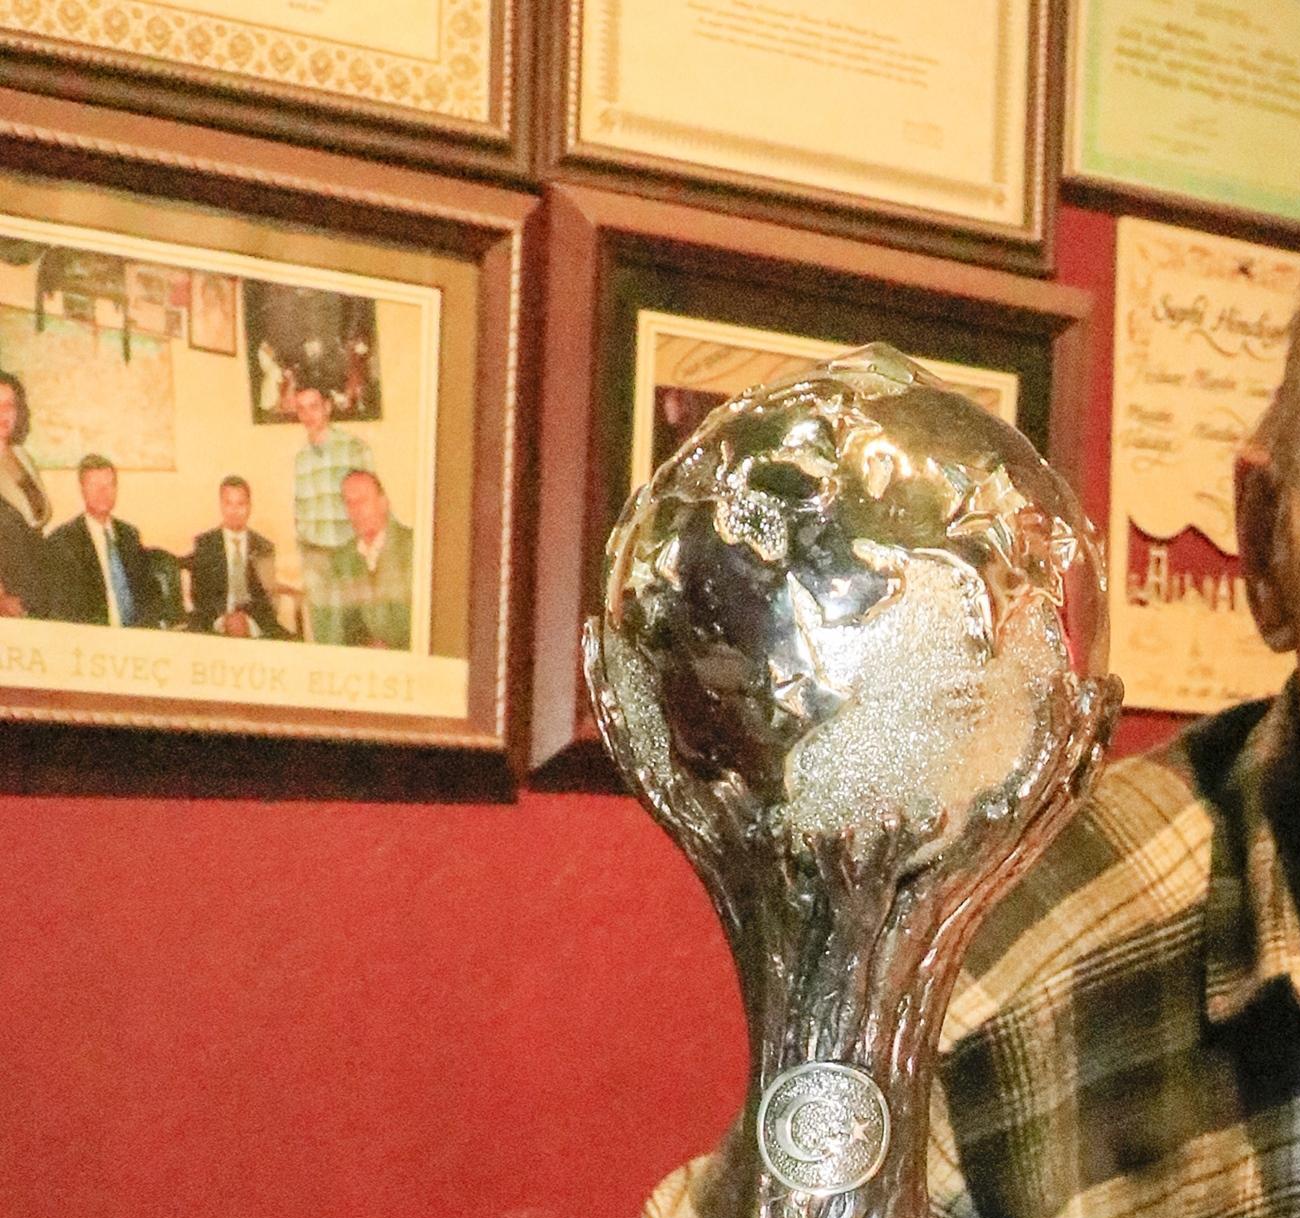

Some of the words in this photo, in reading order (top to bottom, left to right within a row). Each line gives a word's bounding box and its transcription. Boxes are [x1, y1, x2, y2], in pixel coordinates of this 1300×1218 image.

[0, 644, 48, 674] RA
[70, 645, 173, 685] İSVEÇ
[191, 659, 288, 694] BÜYÜK
